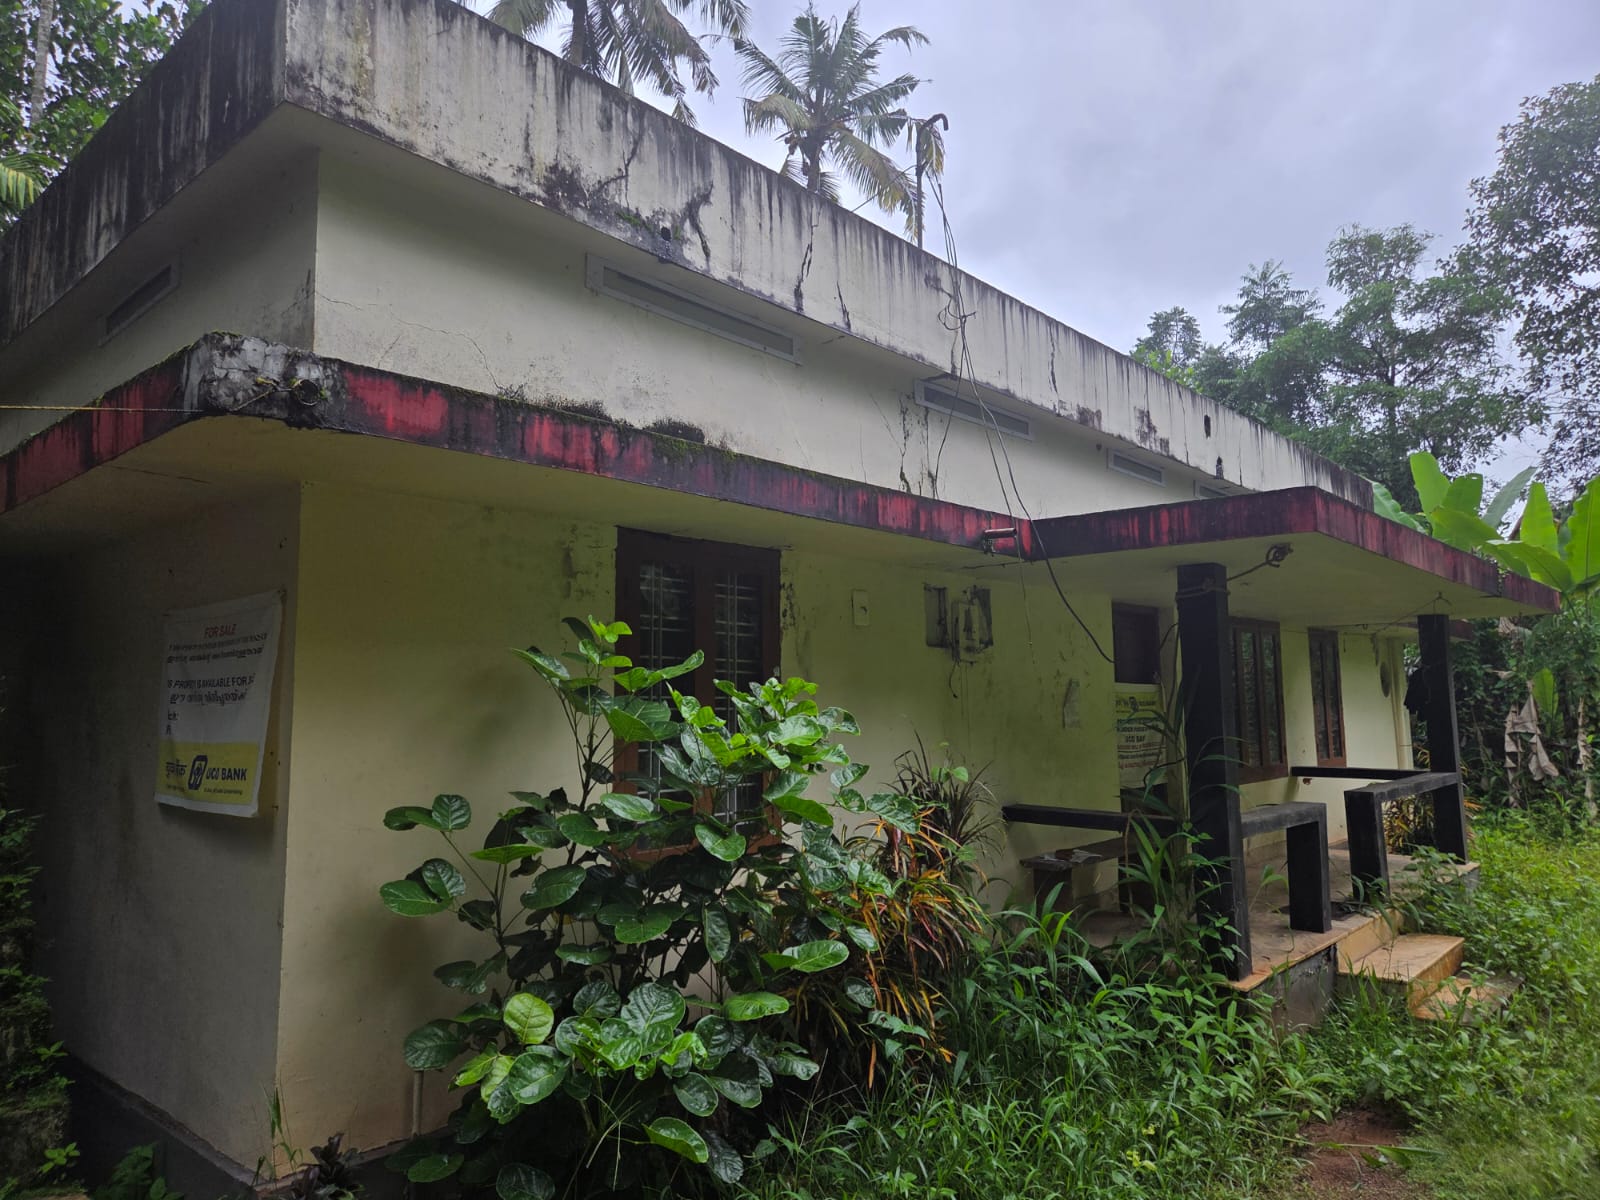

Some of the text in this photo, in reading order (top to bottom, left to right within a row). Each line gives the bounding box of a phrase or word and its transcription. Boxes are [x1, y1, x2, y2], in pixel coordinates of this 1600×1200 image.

[205, 623, 237, 639] FOR SALE
[231, 675, 247, 687] FOR
[221, 767, 248, 781] BANK
